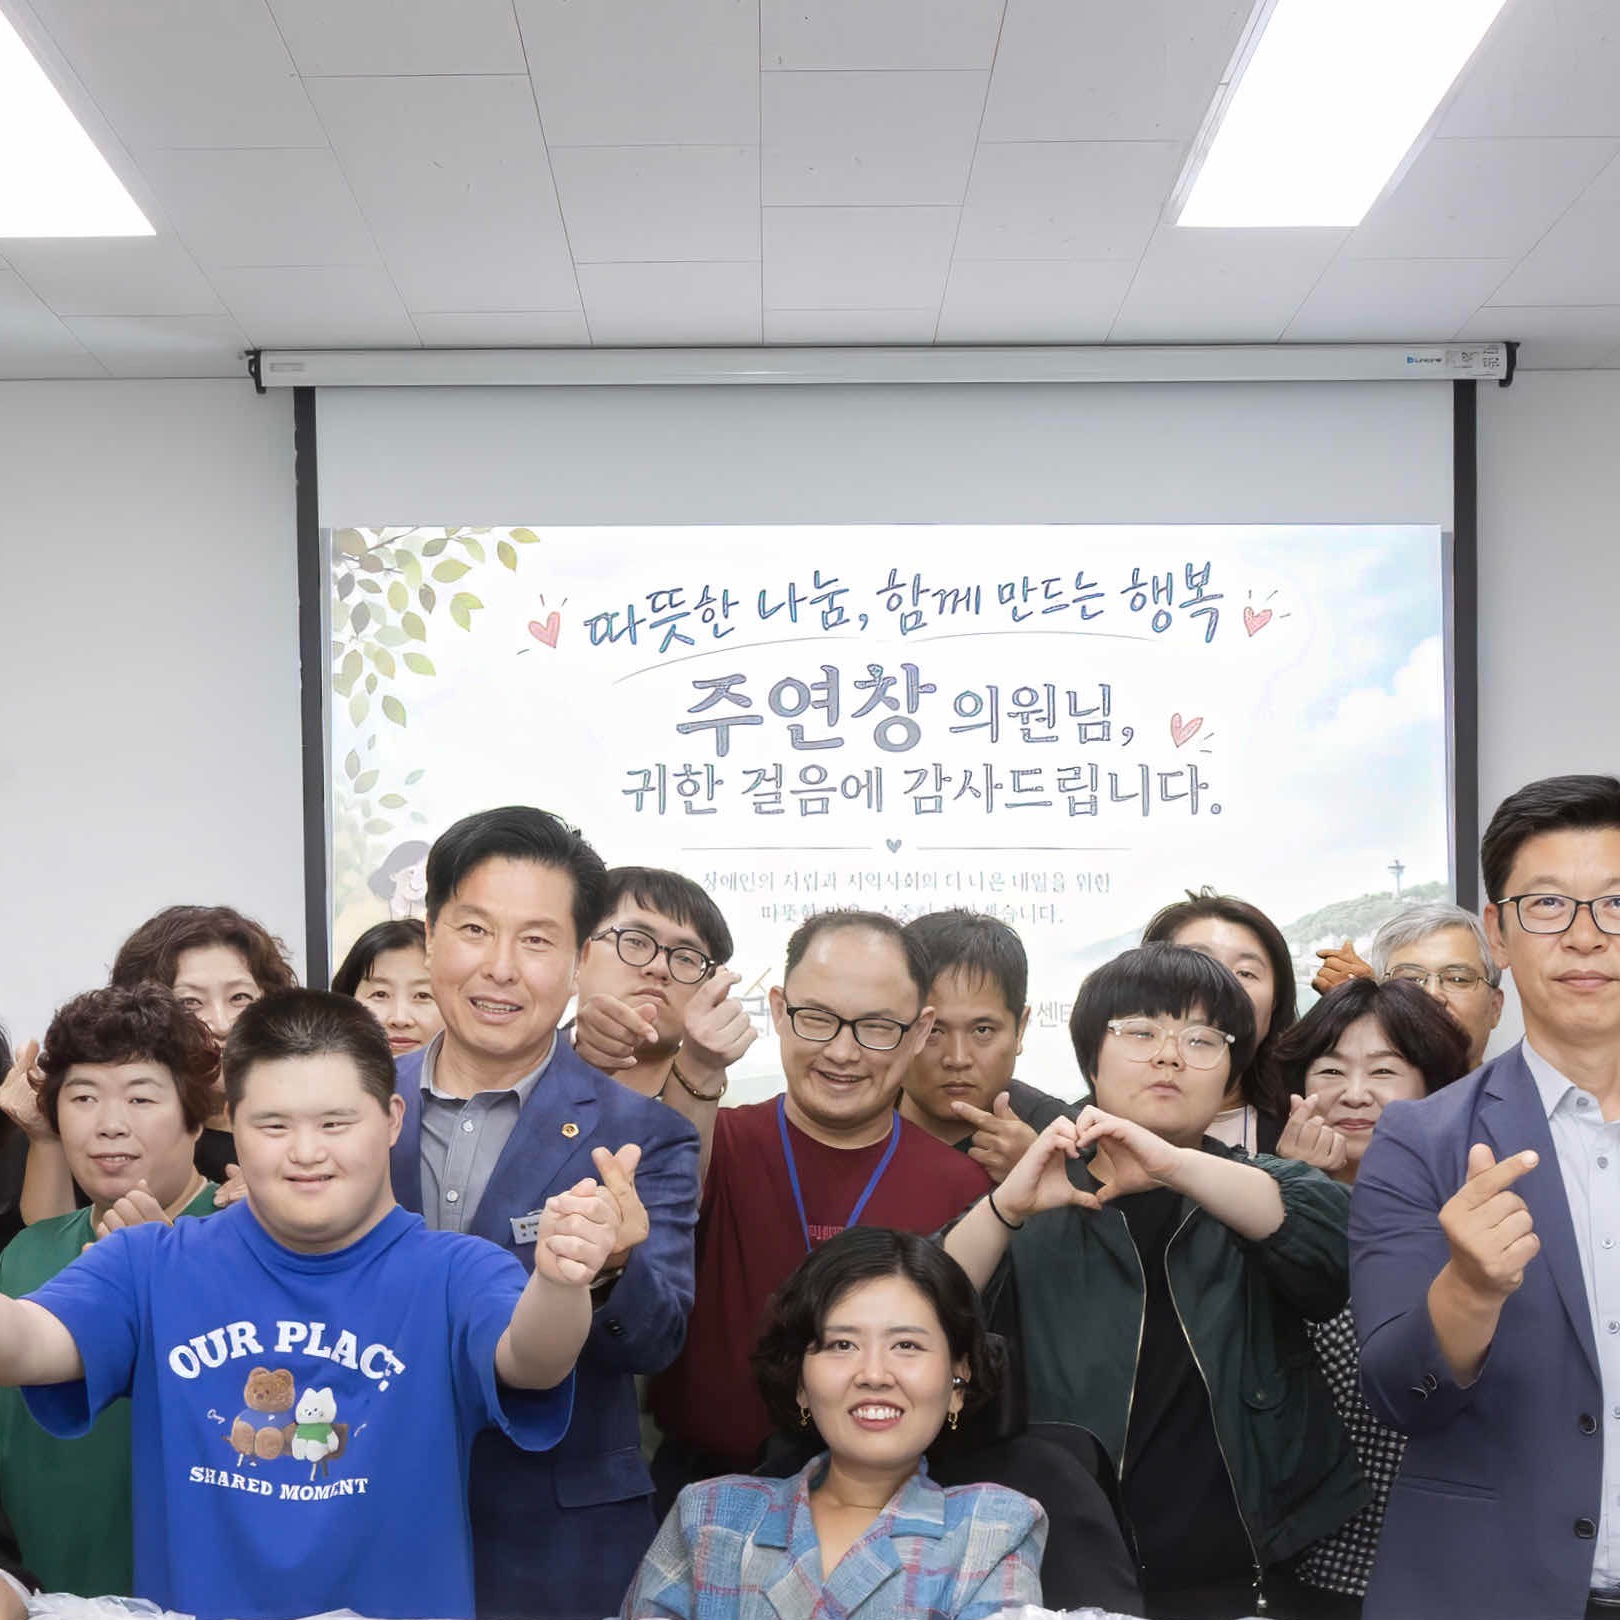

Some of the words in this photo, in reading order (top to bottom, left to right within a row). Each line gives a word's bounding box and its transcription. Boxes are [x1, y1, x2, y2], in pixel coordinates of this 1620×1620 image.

[584, 585, 740, 653] 따뜻한
[757, 569, 869, 636] 나눔,
[876, 568, 981, 636] 함께
[997, 570, 1106, 622] 만드는
[1120, 560, 1225, 644] 행복
[675, 662, 938, 757] 주연창
[948, 683, 1135, 747] 의원님,
[621, 762, 725, 816] 귀한
[741, 762, 884, 817] 걸음에
[902, 762, 1223, 818] 감사드립니다.
[168, 1320, 265, 1380] OUR
[189, 1466, 274, 1497] SHARED
[279, 1477, 370, 1502] MOMENT
